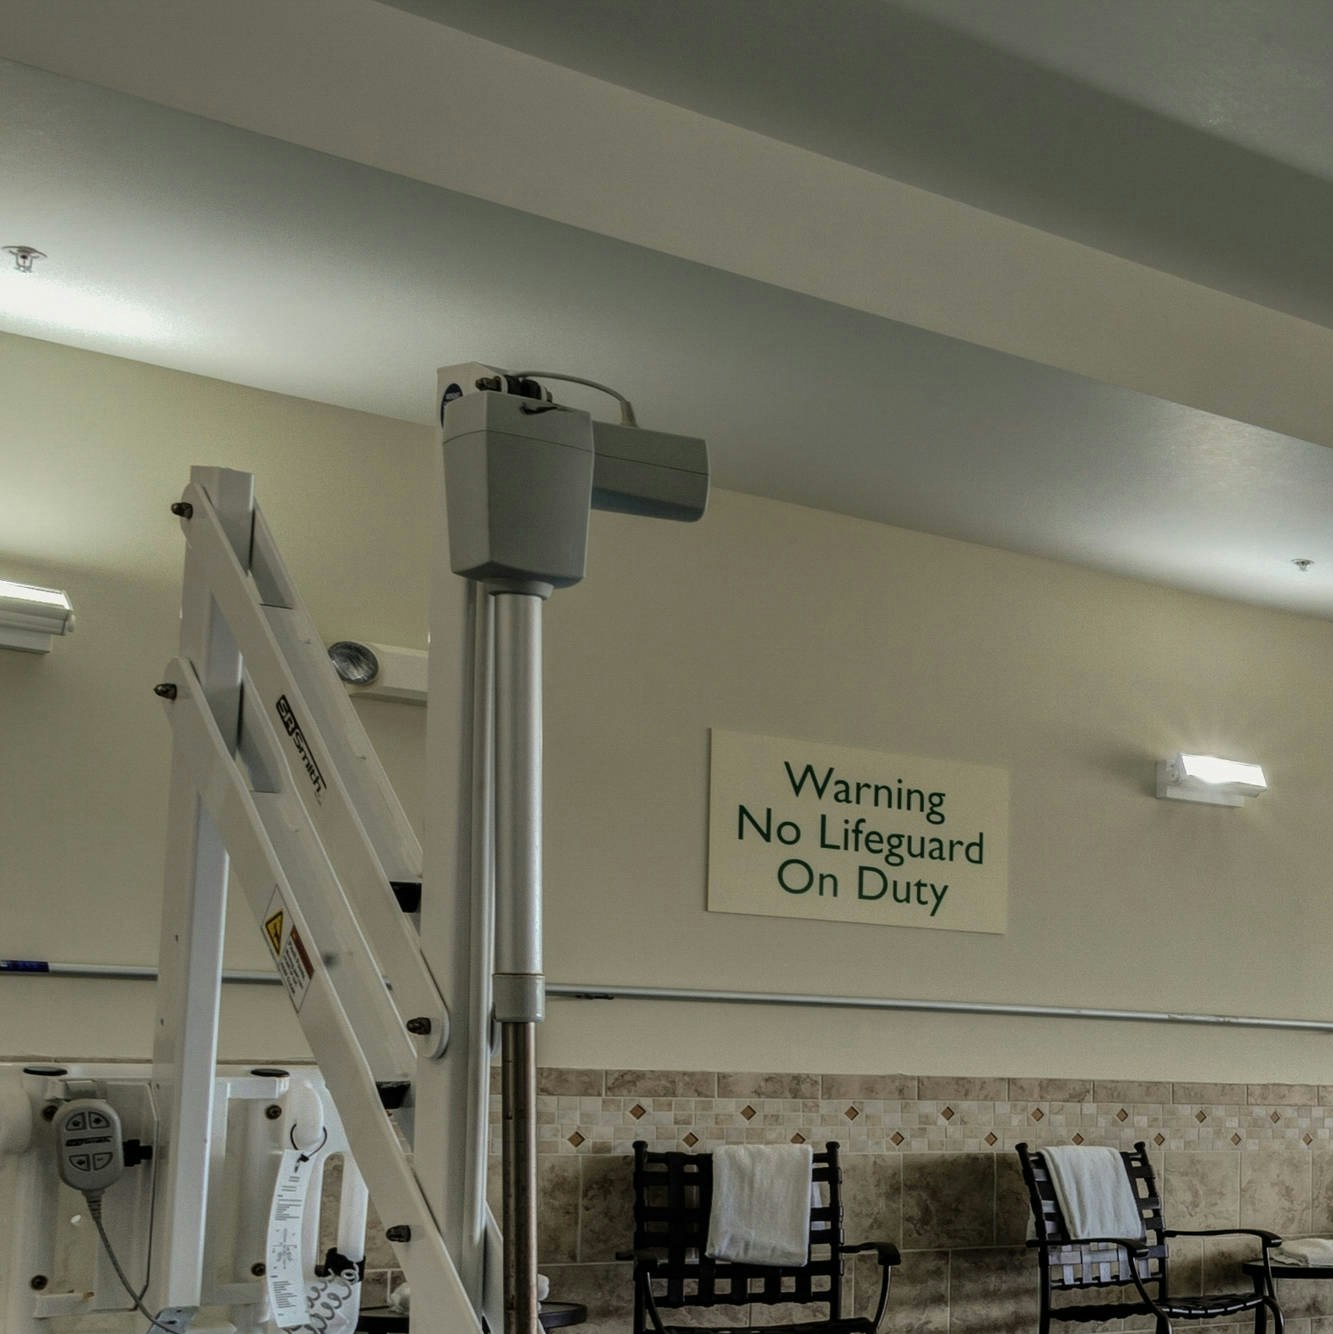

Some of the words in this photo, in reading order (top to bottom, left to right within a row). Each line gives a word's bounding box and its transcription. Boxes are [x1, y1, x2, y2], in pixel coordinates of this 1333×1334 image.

[784, 760, 946, 825] Warning
[738, 804, 801, 846] No
[820, 813, 984, 867] Lifeguard
[777, 858, 838, 898] On
[857, 865, 949, 917] Duty
